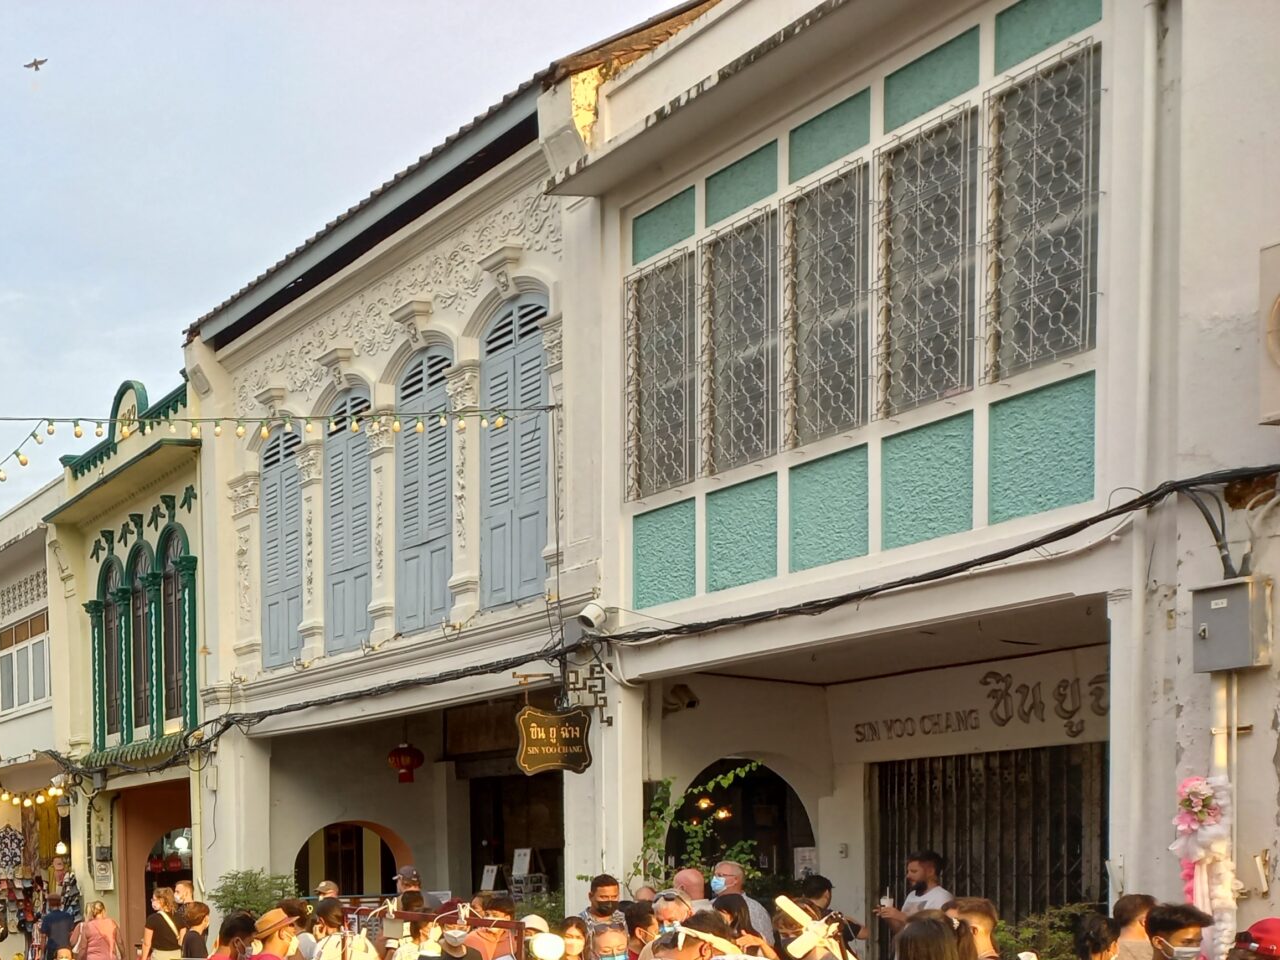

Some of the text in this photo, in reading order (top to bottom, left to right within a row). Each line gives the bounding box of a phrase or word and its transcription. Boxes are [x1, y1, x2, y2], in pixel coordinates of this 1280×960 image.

[854, 709, 980, 743] SIN YOO CHANG
[527, 745, 583, 754] SIN YOO CHANG
